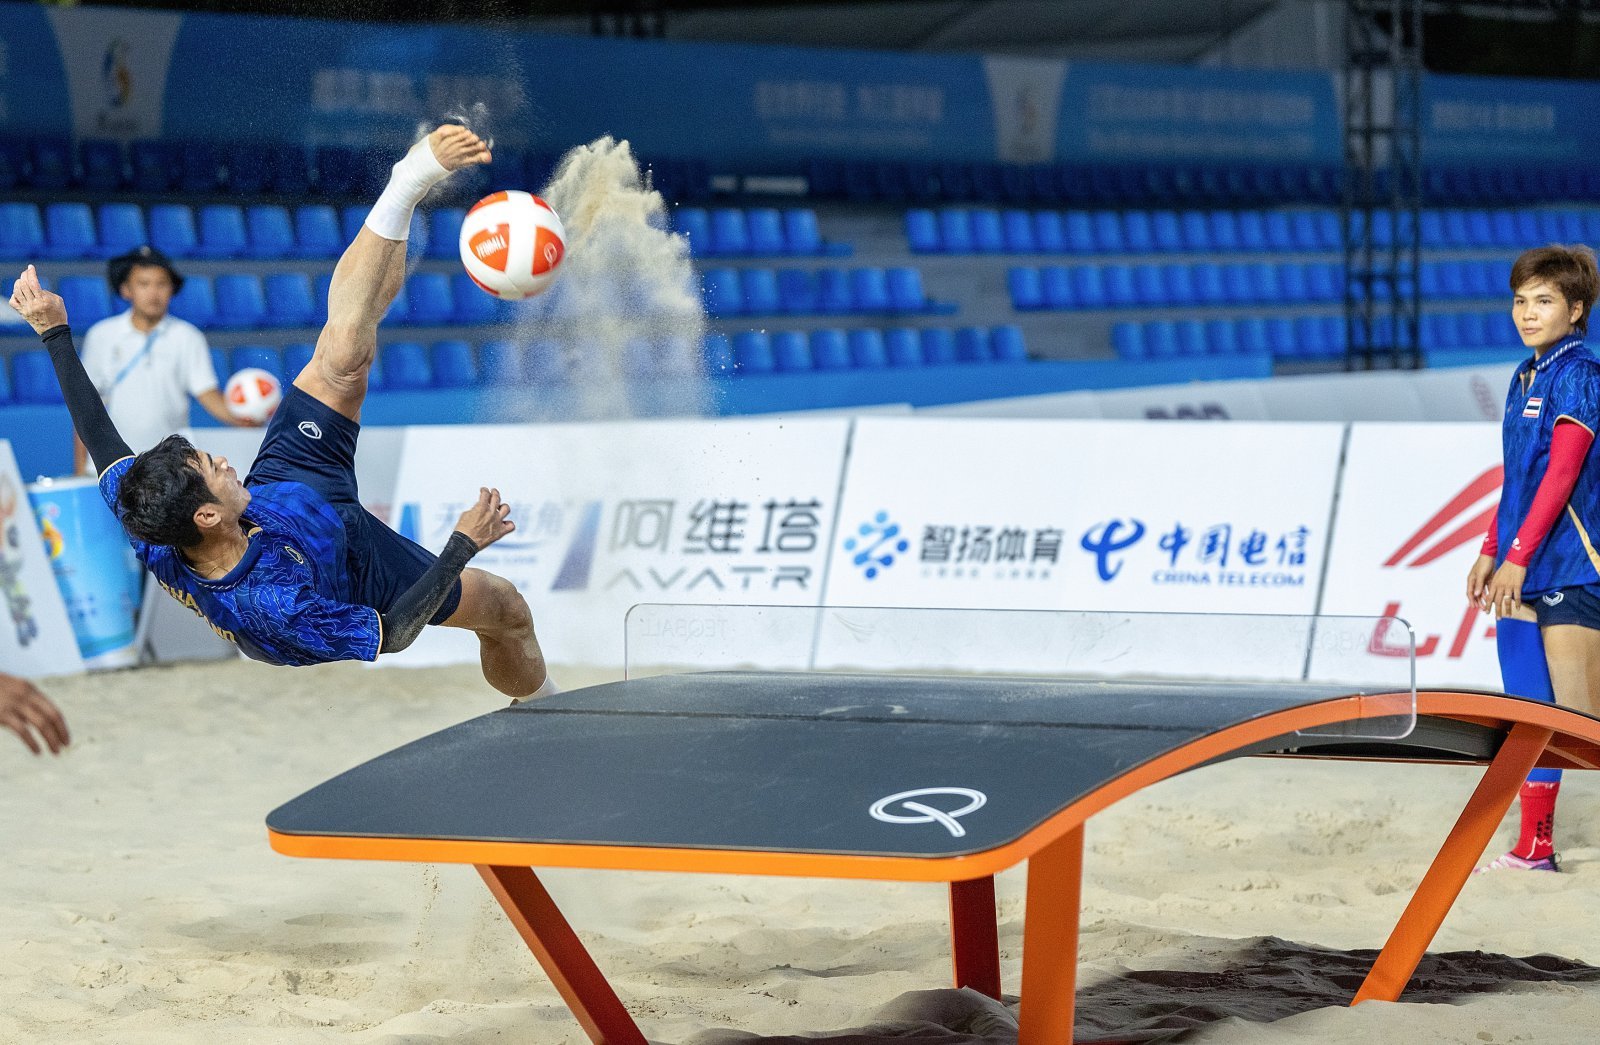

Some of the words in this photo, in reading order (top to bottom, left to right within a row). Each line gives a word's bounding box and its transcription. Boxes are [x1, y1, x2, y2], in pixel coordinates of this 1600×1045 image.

[608, 499, 822, 554] 阿维塔
[920, 524, 1065, 564] 智扬体育
[1157, 521, 1311, 567] 中国电信
[603, 566, 813, 590] AVATR
[1152, 571, 1211, 584] CHINA
[1217, 573, 1305, 586] TELECOM
